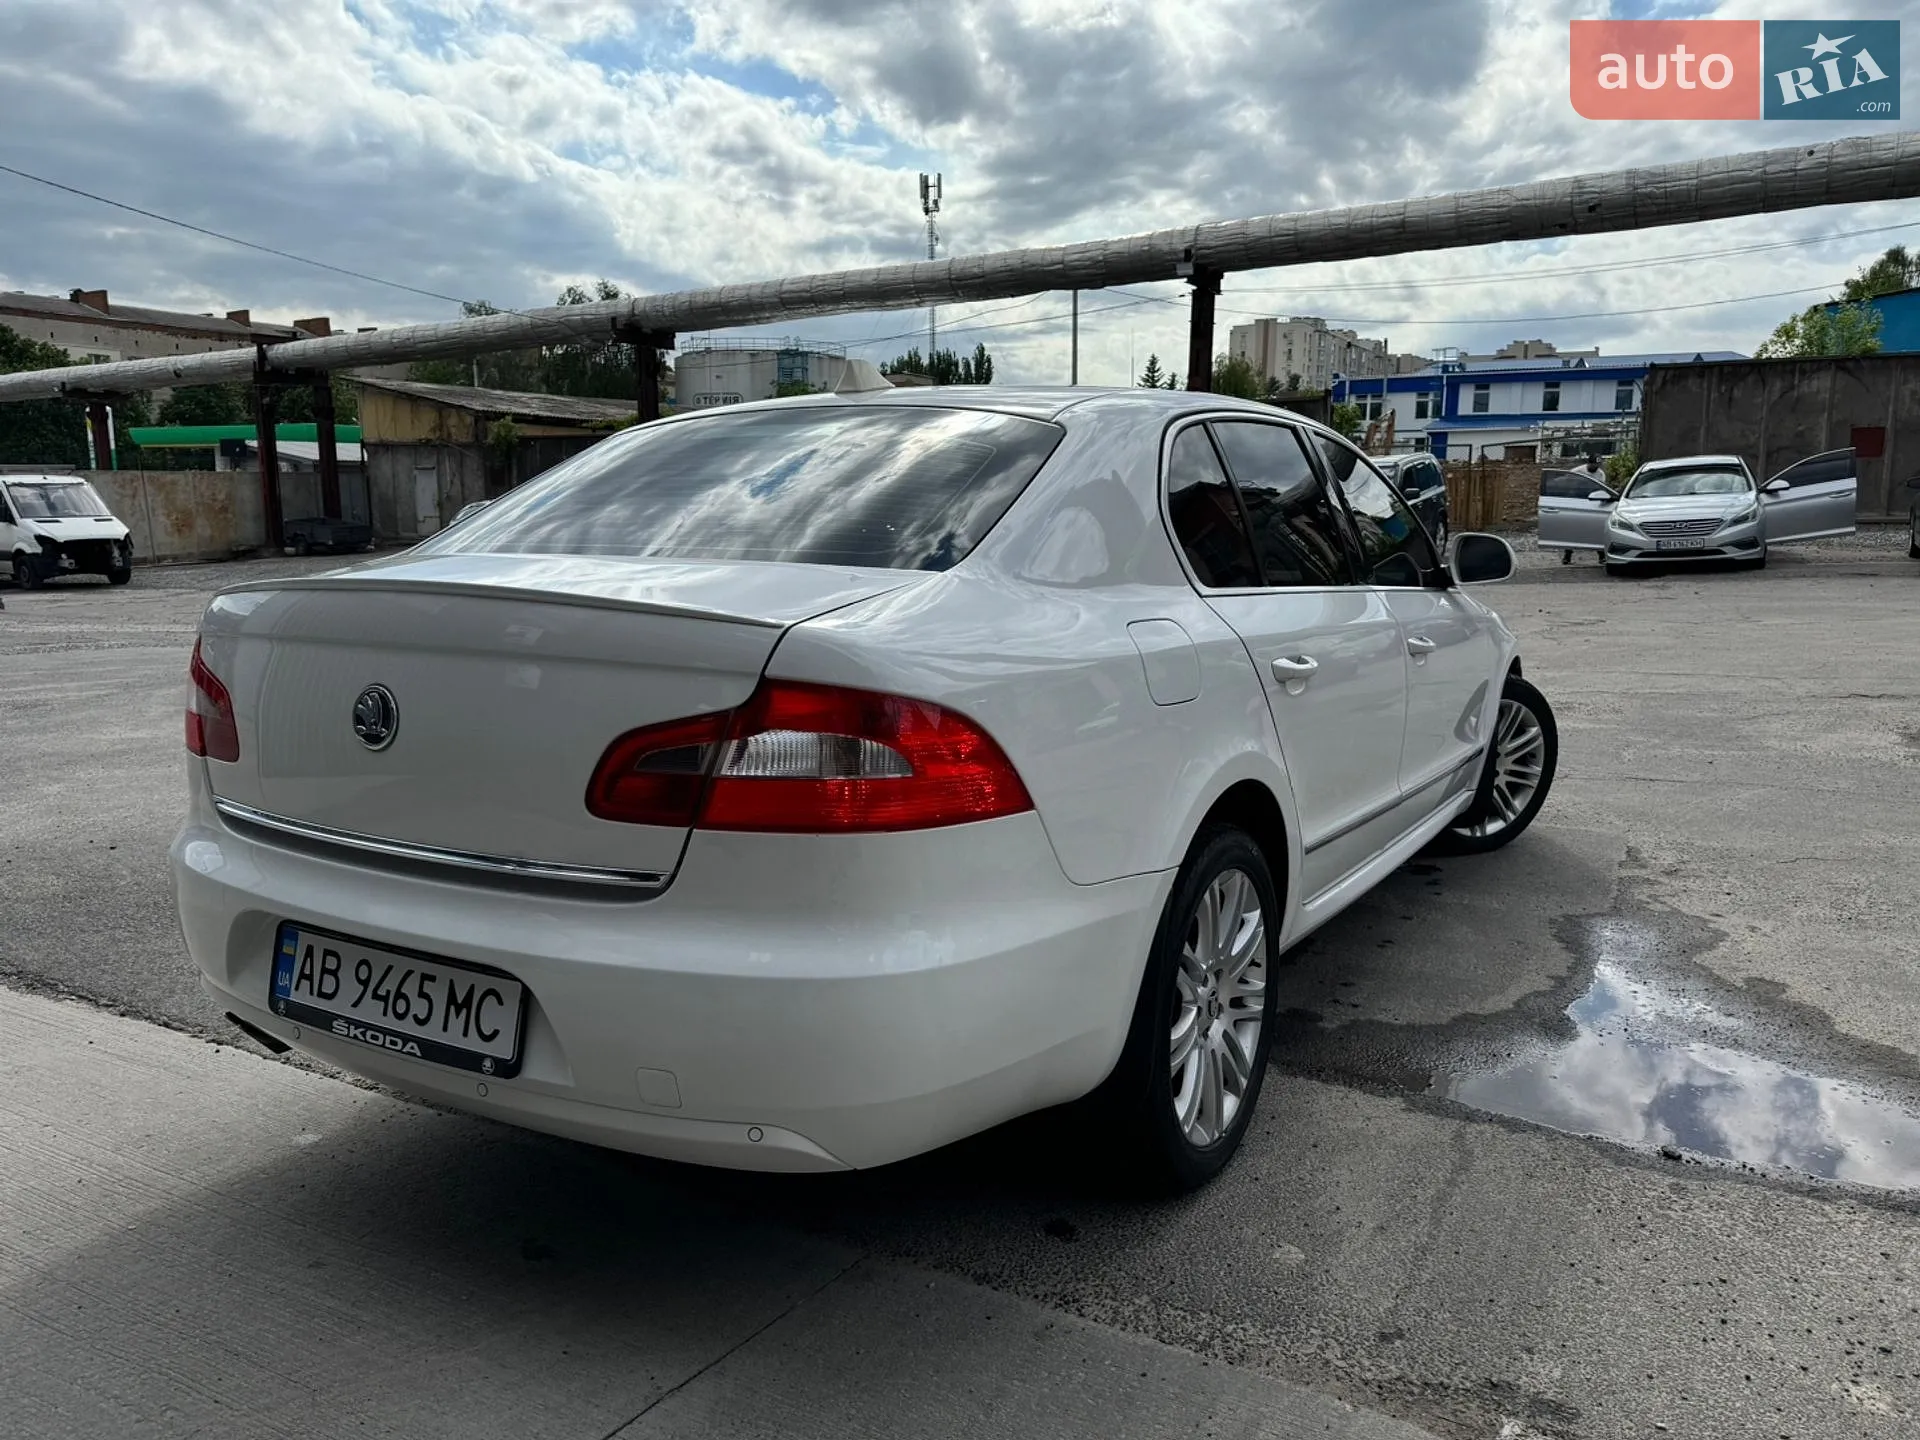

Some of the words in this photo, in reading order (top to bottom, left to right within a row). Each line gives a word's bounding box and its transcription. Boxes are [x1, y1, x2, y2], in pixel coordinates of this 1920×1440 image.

[278, 971, 290, 987] UA
[294, 943, 342, 1001] AB
[350, 958, 437, 1027] 9465
[442, 978, 504, 1043] MC
[331, 1019, 422, 1058] ŠKODA
